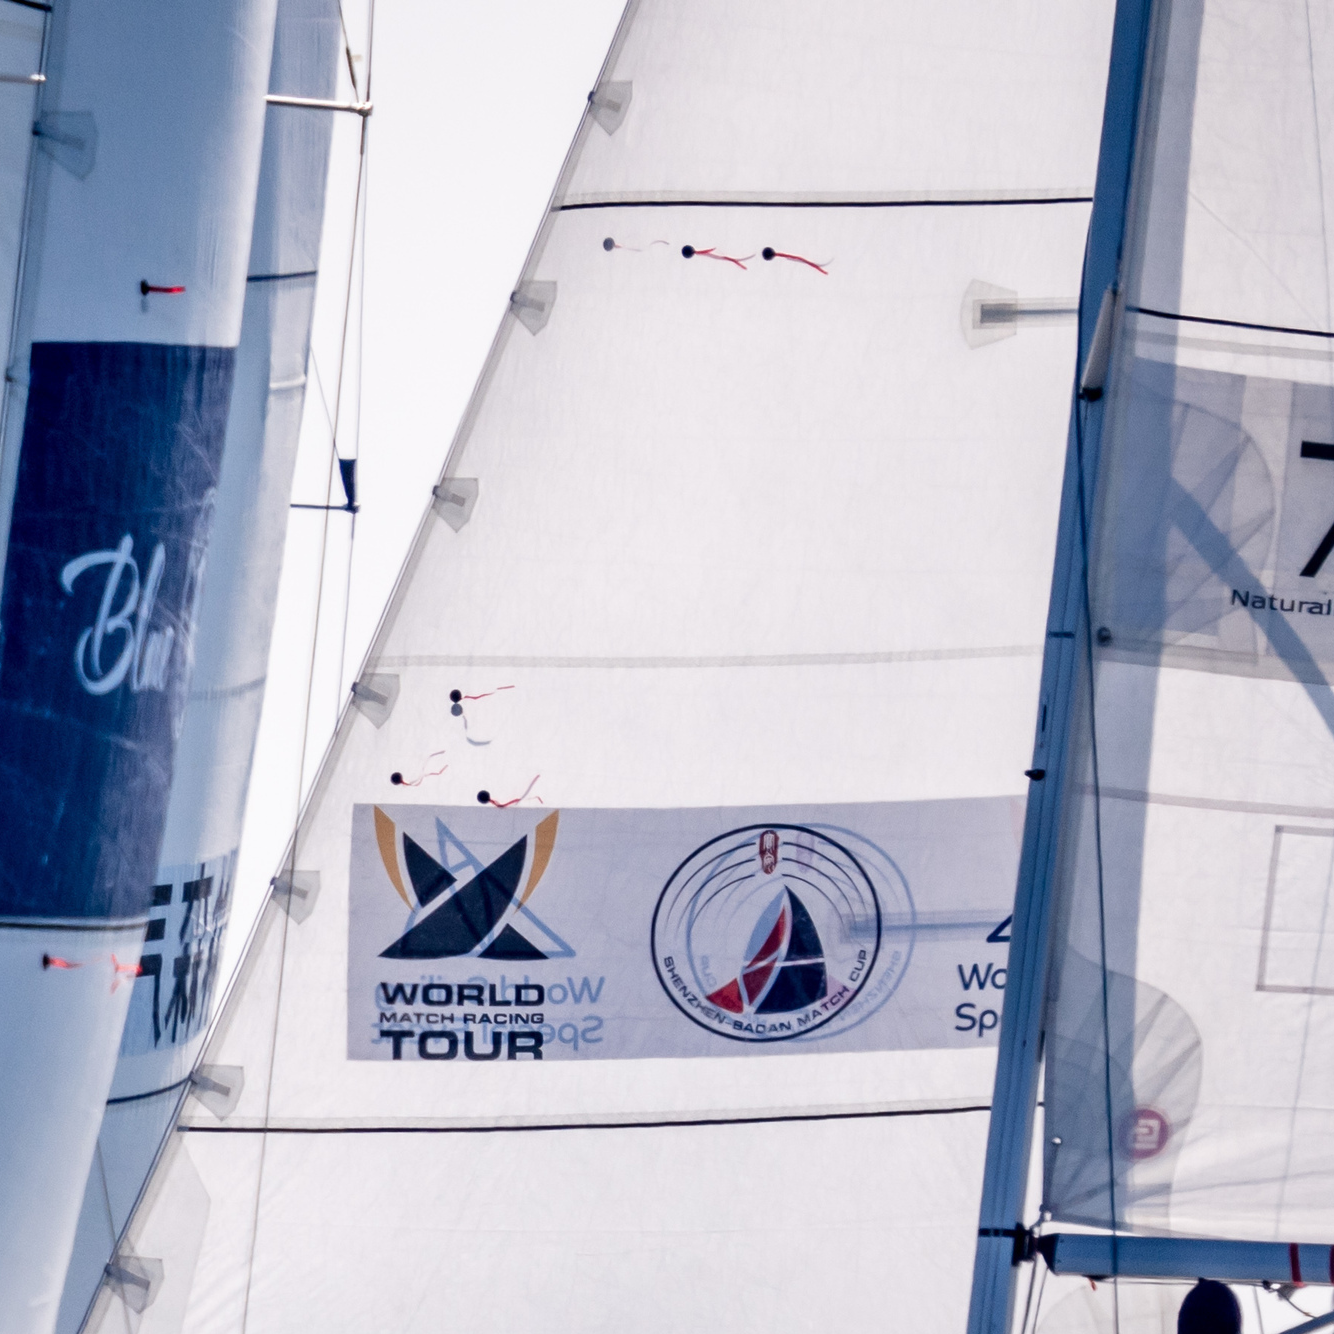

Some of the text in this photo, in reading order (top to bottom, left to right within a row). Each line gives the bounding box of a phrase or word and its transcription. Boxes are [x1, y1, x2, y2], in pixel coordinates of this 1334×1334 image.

[1230, 588, 1332, 616] Natural
[379, 981, 545, 1007] WORLD
[796, 985, 850, 1025] MATCH
[848, 949, 867, 983] CUP
[379, 1012, 545, 1025] MATCH RACING
[379, 1029, 544, 1061] TOUR
